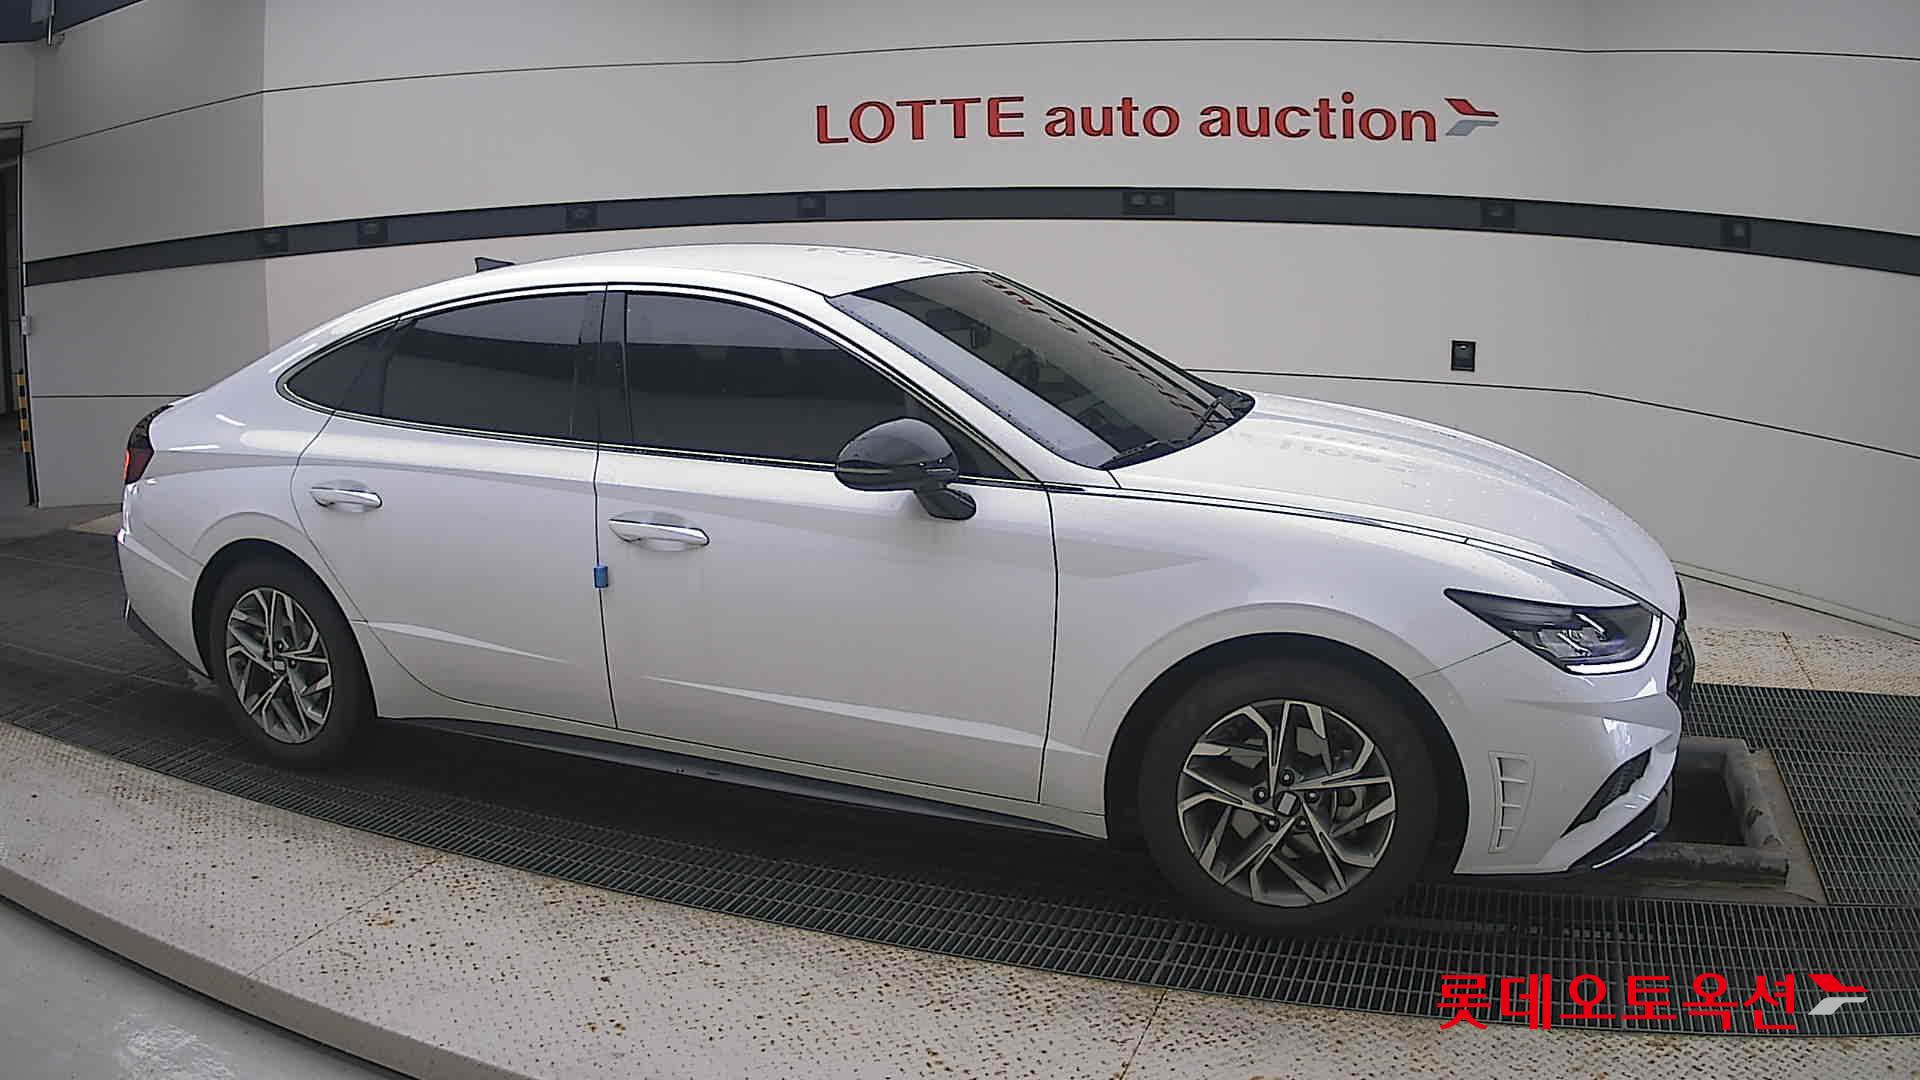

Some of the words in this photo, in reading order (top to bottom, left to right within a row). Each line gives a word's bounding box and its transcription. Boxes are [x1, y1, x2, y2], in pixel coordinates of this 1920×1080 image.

[816, 95, 1024, 143] LOTTE
[1044, 96, 1180, 138] auto
[1199, 91, 1437, 143] auction
